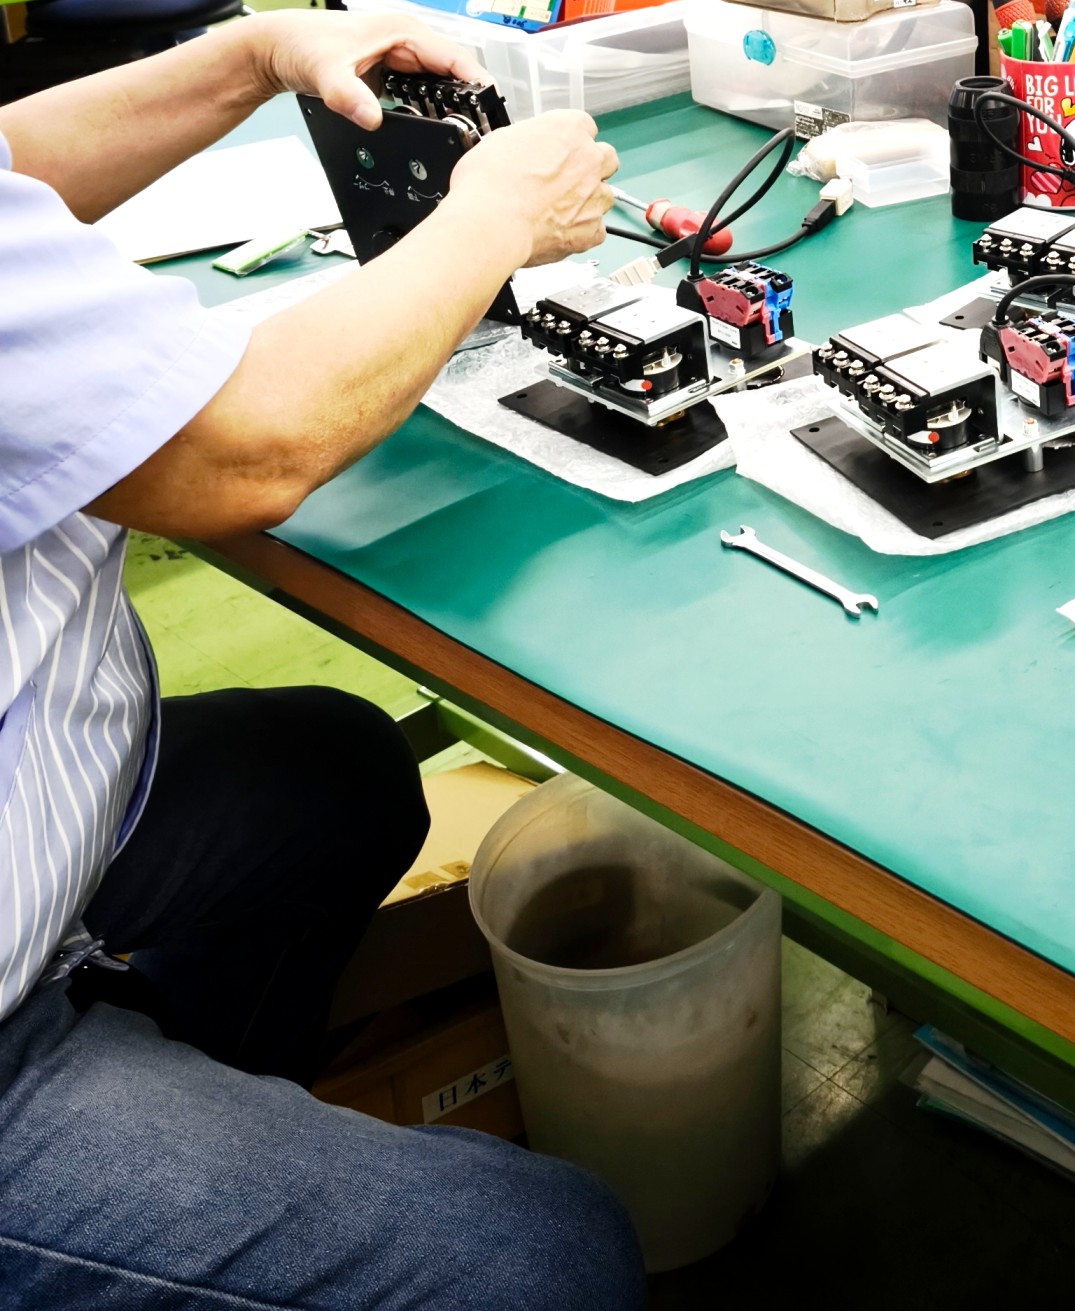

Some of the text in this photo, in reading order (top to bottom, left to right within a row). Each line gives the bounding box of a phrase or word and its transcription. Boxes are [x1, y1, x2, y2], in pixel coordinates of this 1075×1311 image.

[1025, 74, 1059, 97] BIG
[1026, 95, 1055, 114] FOR
[1027, 113, 1062, 135] YOU
[438, 1059, 512, 1112] 日本テ
